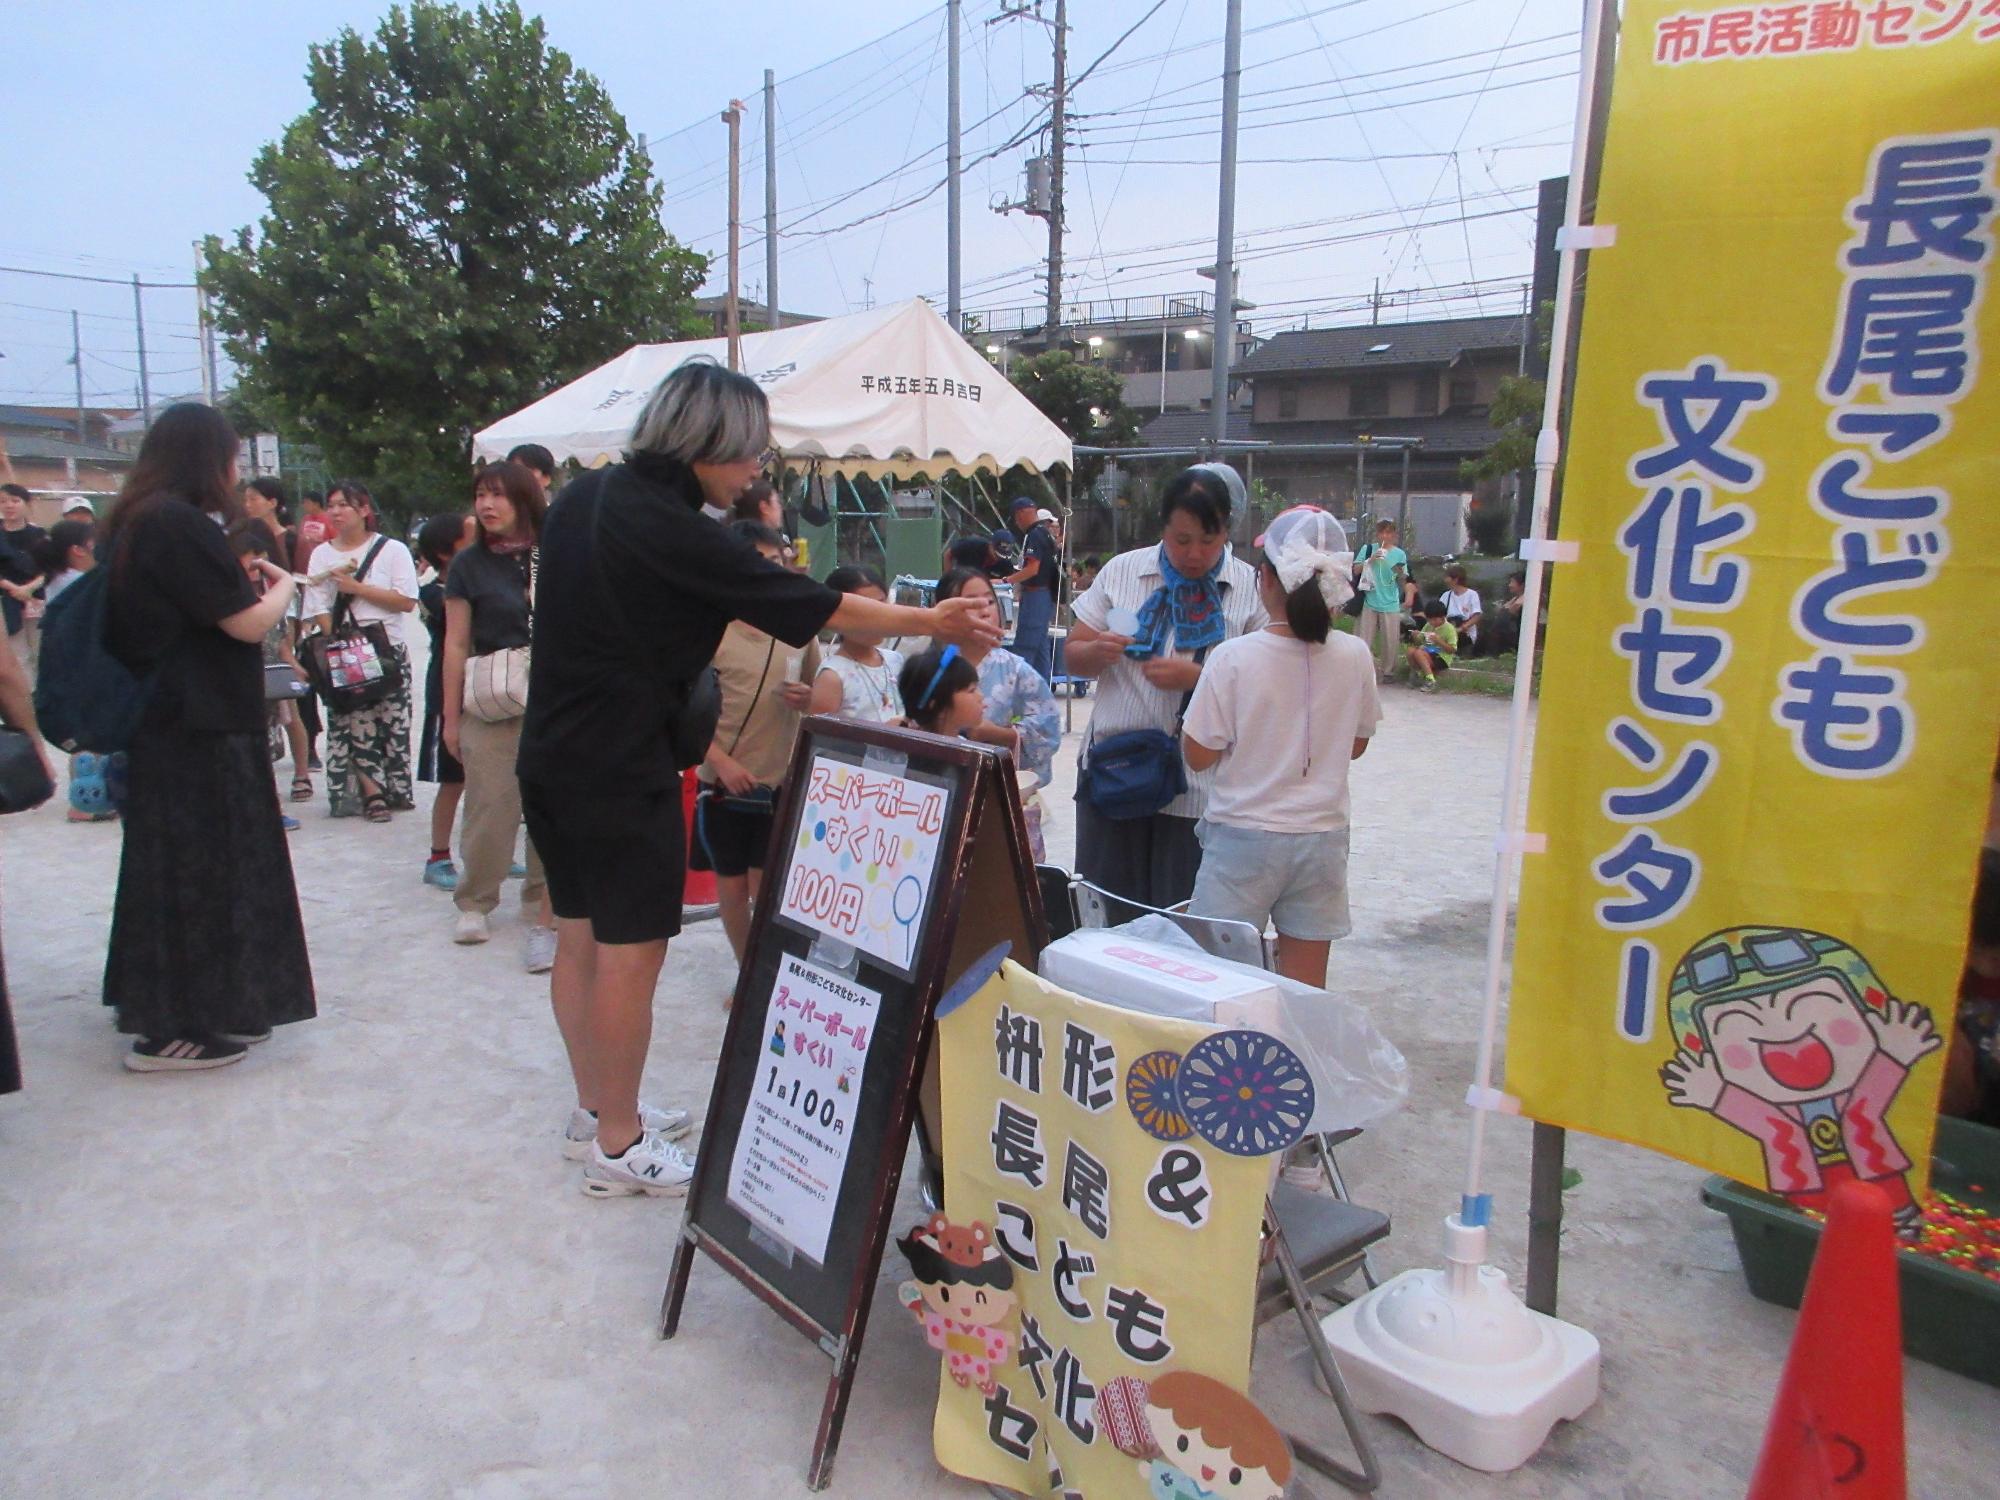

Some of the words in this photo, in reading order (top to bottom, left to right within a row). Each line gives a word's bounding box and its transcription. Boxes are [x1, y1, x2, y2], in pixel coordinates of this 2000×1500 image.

[861, 375, 981, 402] 平成五年五月吉日
[1780, 138, 1993, 770] 長尾こども
[1600, 363, 1768, 1037] 文化センター
[808, 768, 941, 834] スーパーボール
[826, 816, 899, 867] すくい
[789, 864, 863, 935] 100円
[775, 985, 867, 1051] スーパーボール
[794, 1031, 833, 1068] すくい
[994, 1004, 1116, 1111] 枡形
[643, 1163, 663, 1178] N
[996, 1203, 1171, 1362] こども
